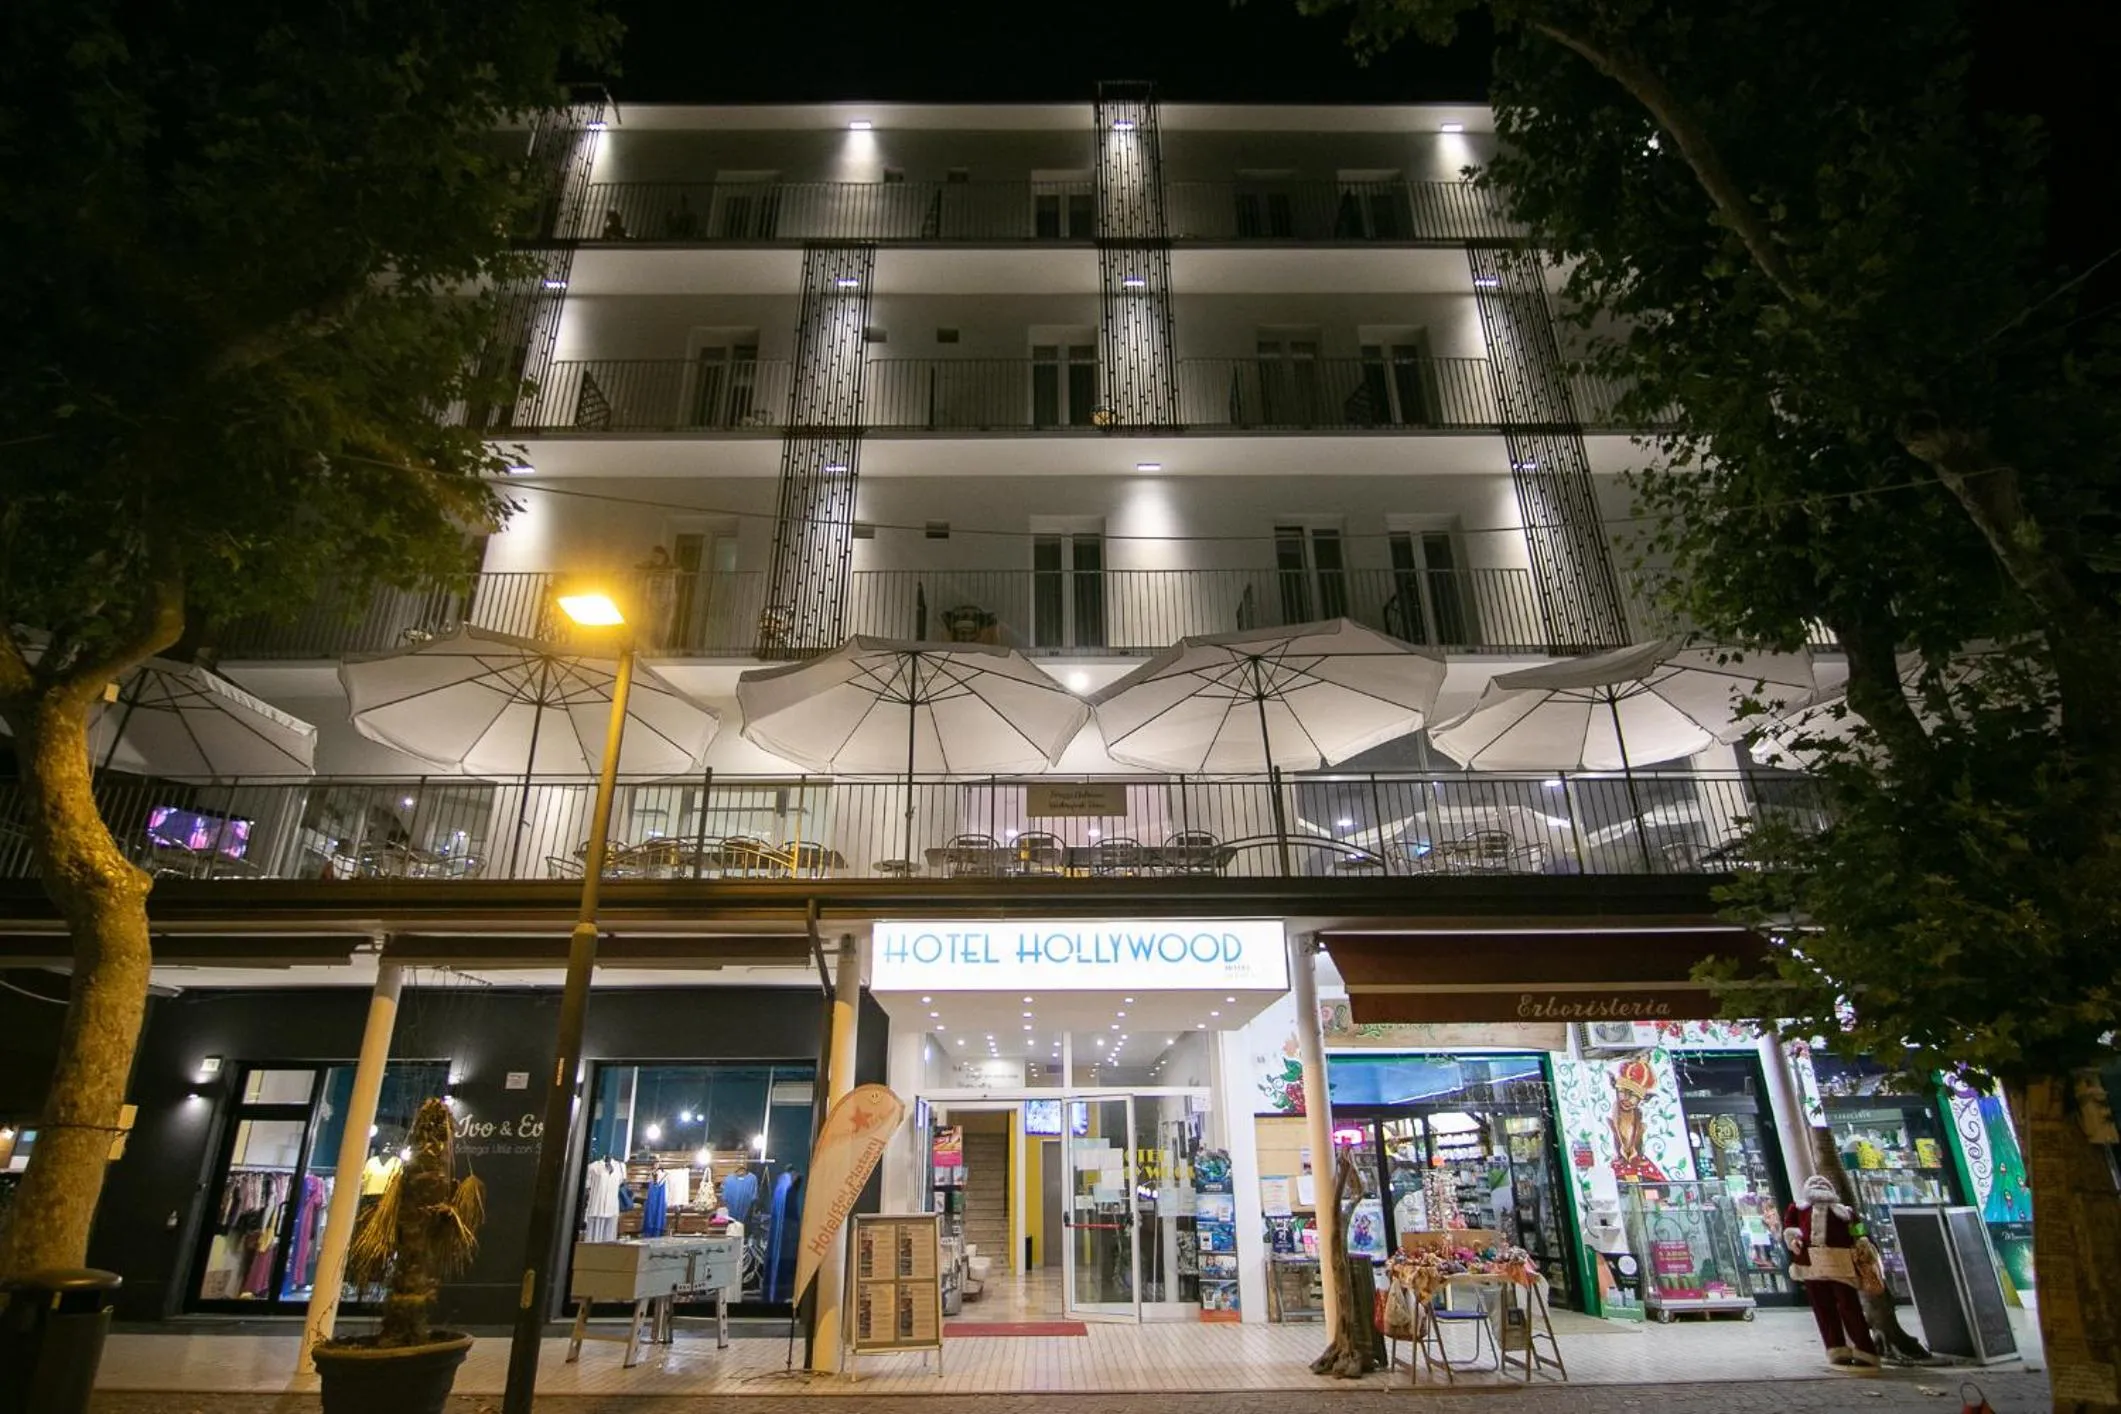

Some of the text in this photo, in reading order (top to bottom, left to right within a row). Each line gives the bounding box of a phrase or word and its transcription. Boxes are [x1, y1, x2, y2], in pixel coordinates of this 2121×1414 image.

[883, 933, 1242, 964] HOTEL HOLLYWOOD
[1516, 994, 1672, 1018] Erboristeria
[454, 1114, 544, 1138] Ivo & Ev
[807, 1211, 842, 1257] Hotel
